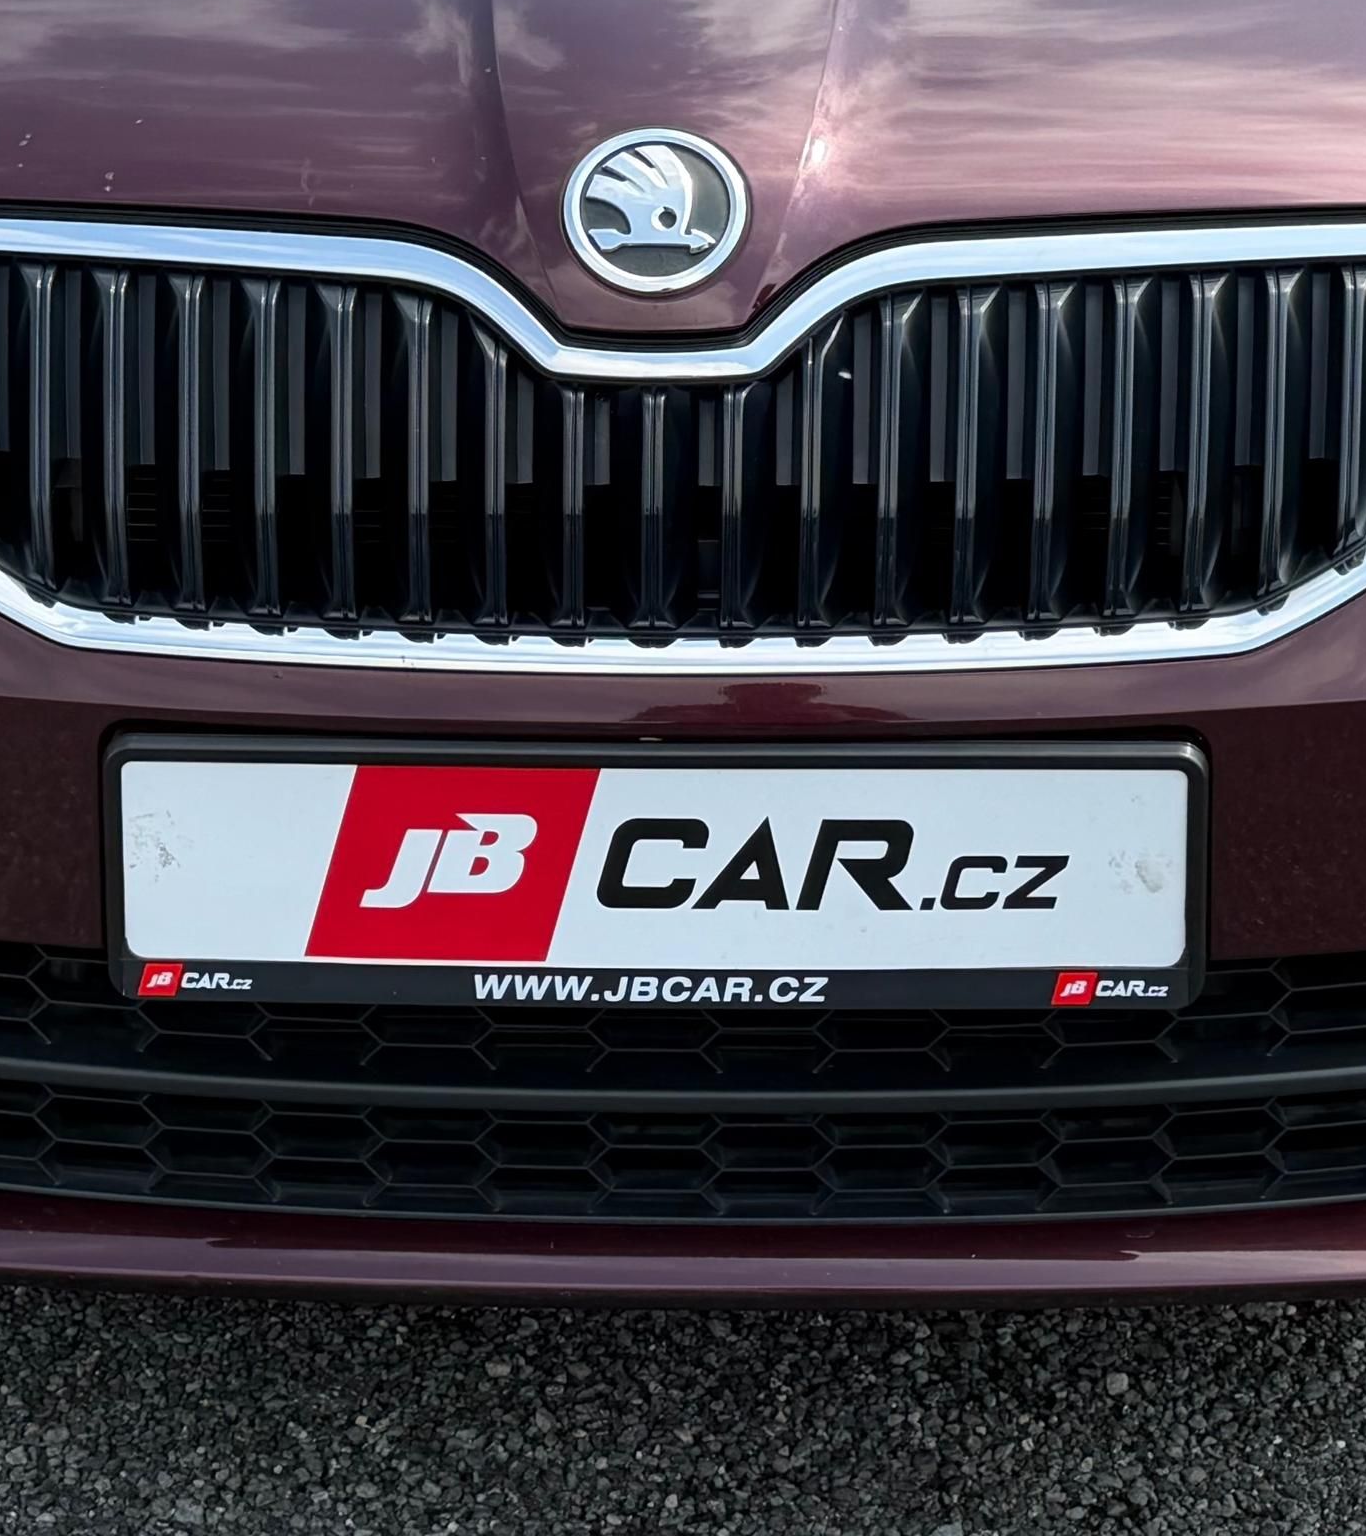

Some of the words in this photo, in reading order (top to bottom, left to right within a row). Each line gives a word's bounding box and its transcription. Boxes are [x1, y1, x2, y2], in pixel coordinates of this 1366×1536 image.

[359, 813, 538, 908] JB
[146, 971, 174, 988] JB
[474, 973, 829, 1004] WWW.JBCAR.CZ
[1059, 980, 1088, 997] JB
